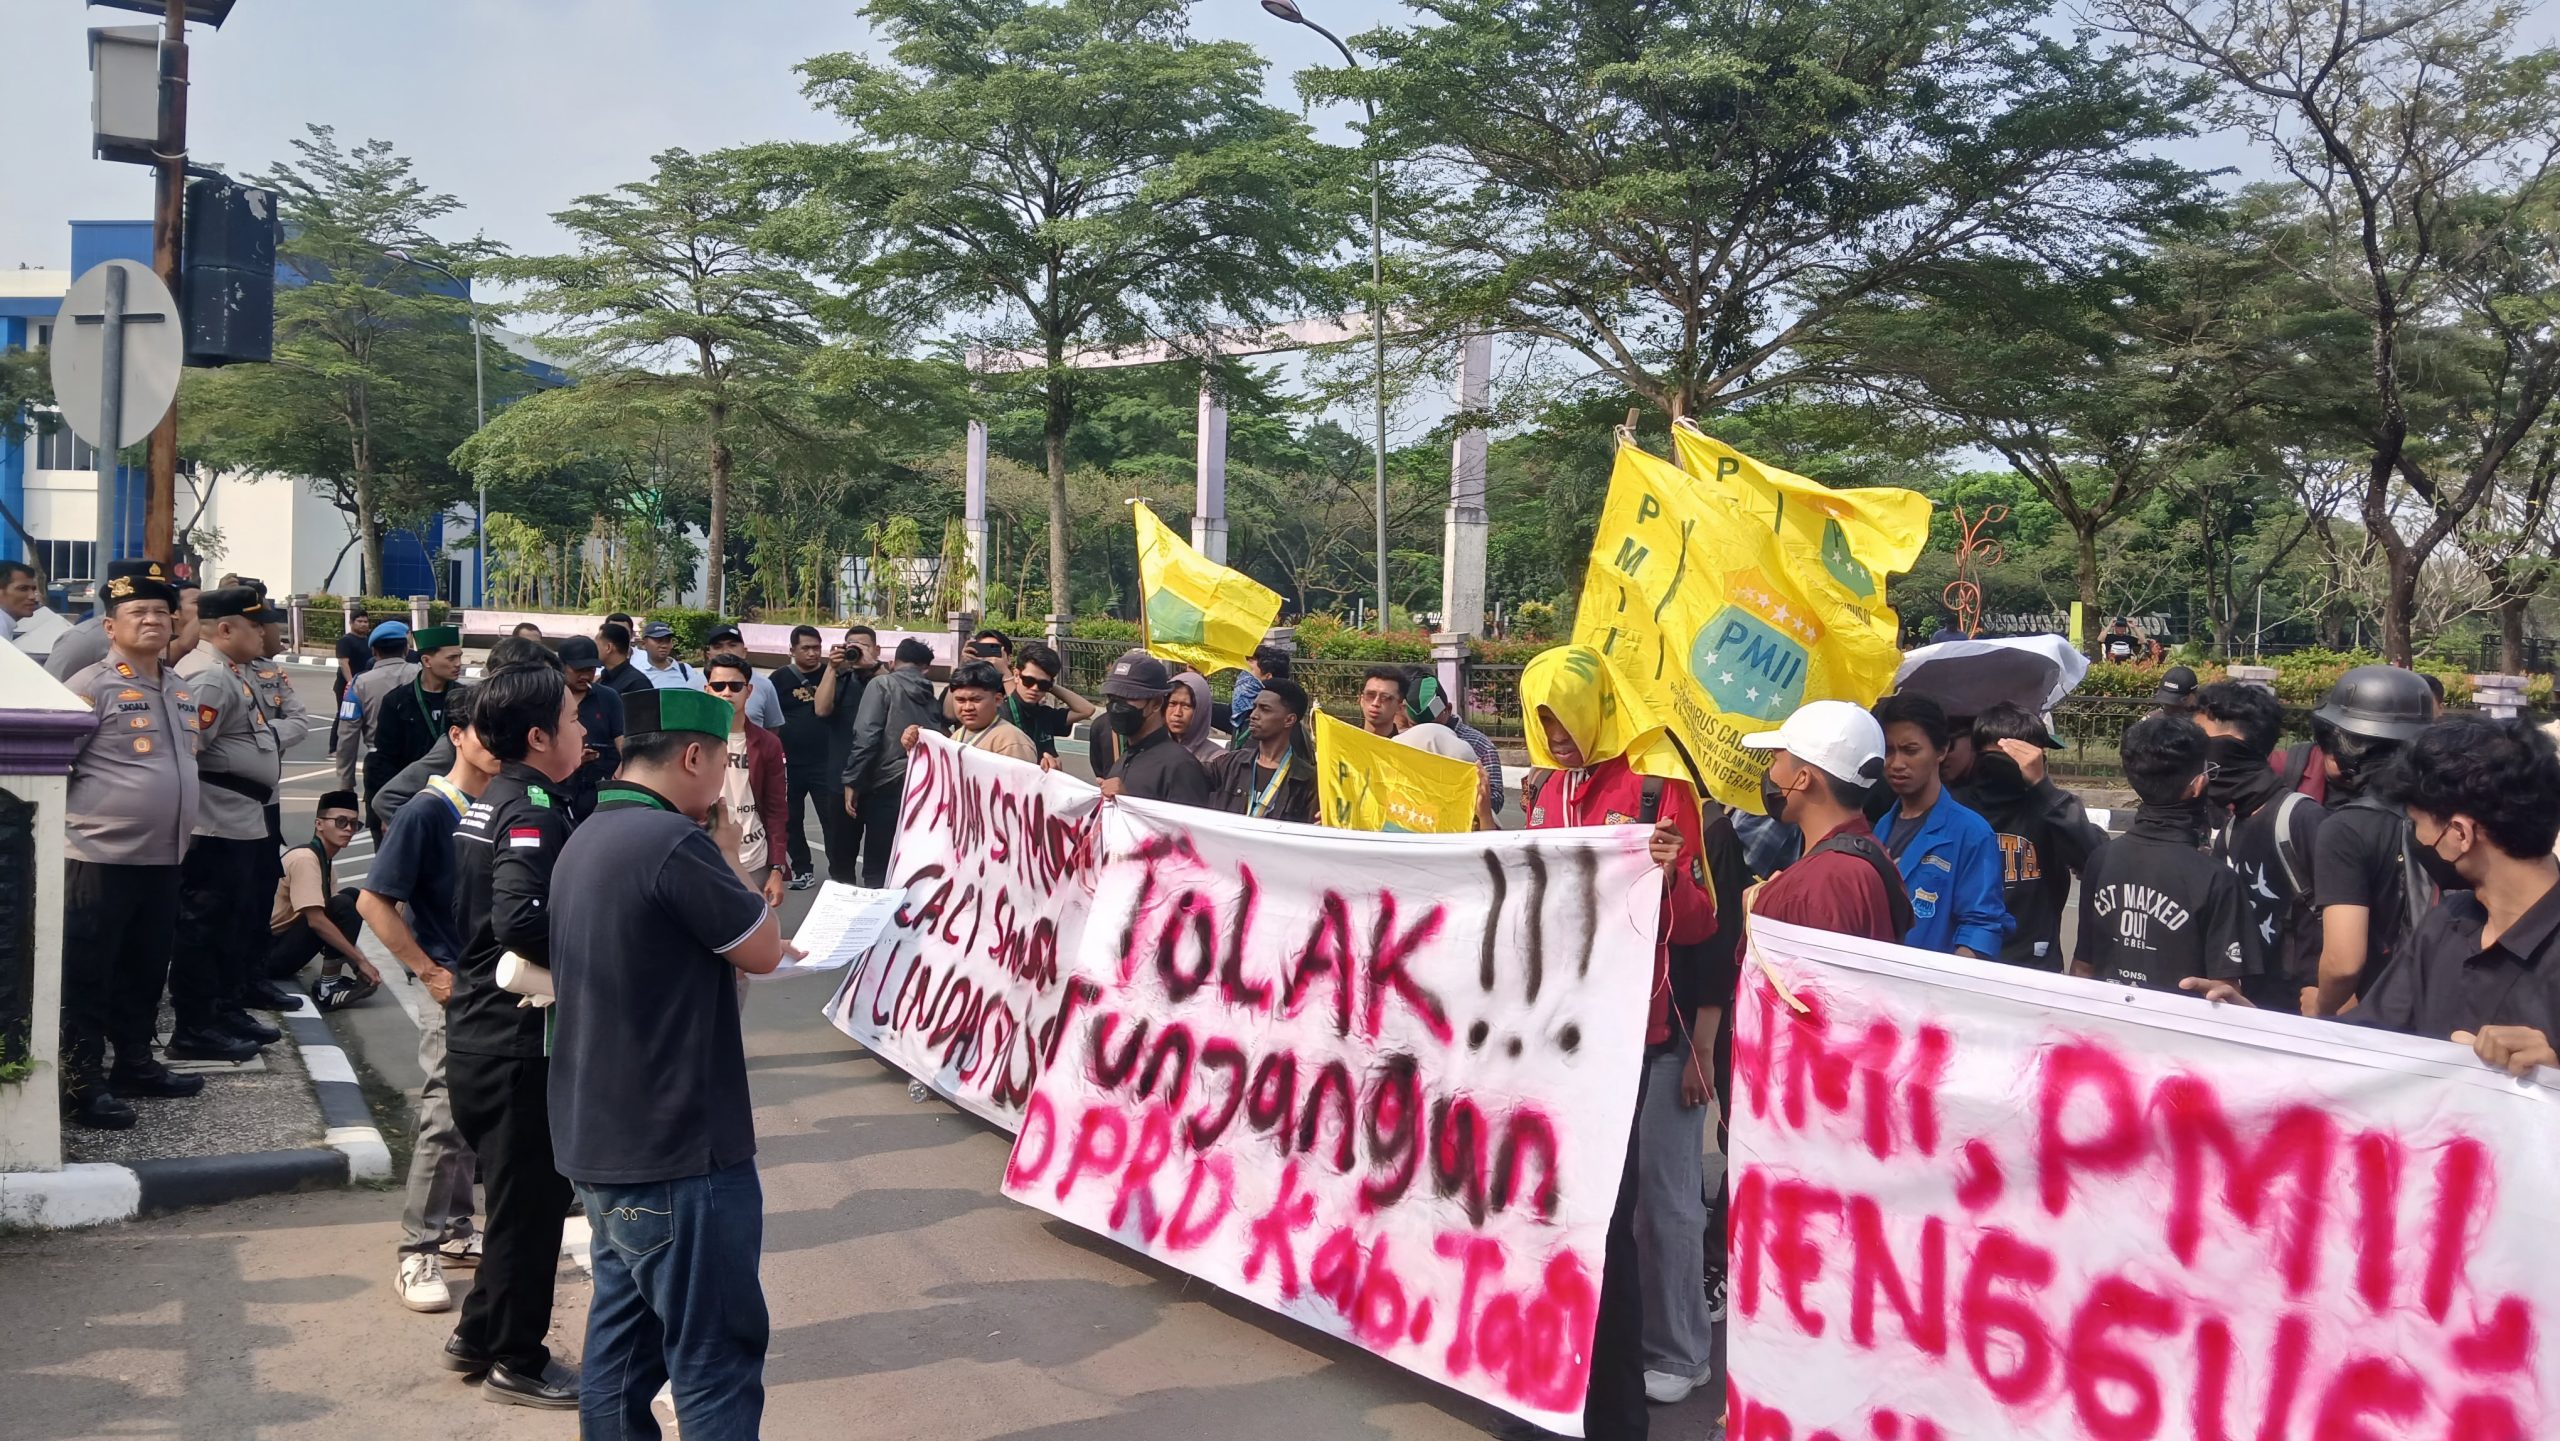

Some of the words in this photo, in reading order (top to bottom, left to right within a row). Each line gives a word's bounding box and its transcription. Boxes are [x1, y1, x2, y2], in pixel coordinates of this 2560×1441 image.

[1714, 619, 1802, 690] PMII
[118, 703, 150, 712] SAGALA
[1700, 750, 1762, 793] TANGERANG
[1719, 748, 1745, 770] ISLAM
[2120, 909, 2149, 941] OUT
[2123, 883, 2190, 931] MAXXED
[1118, 830, 1454, 1046] TOLAK
[1006, 1088, 1236, 1250] DPRD
